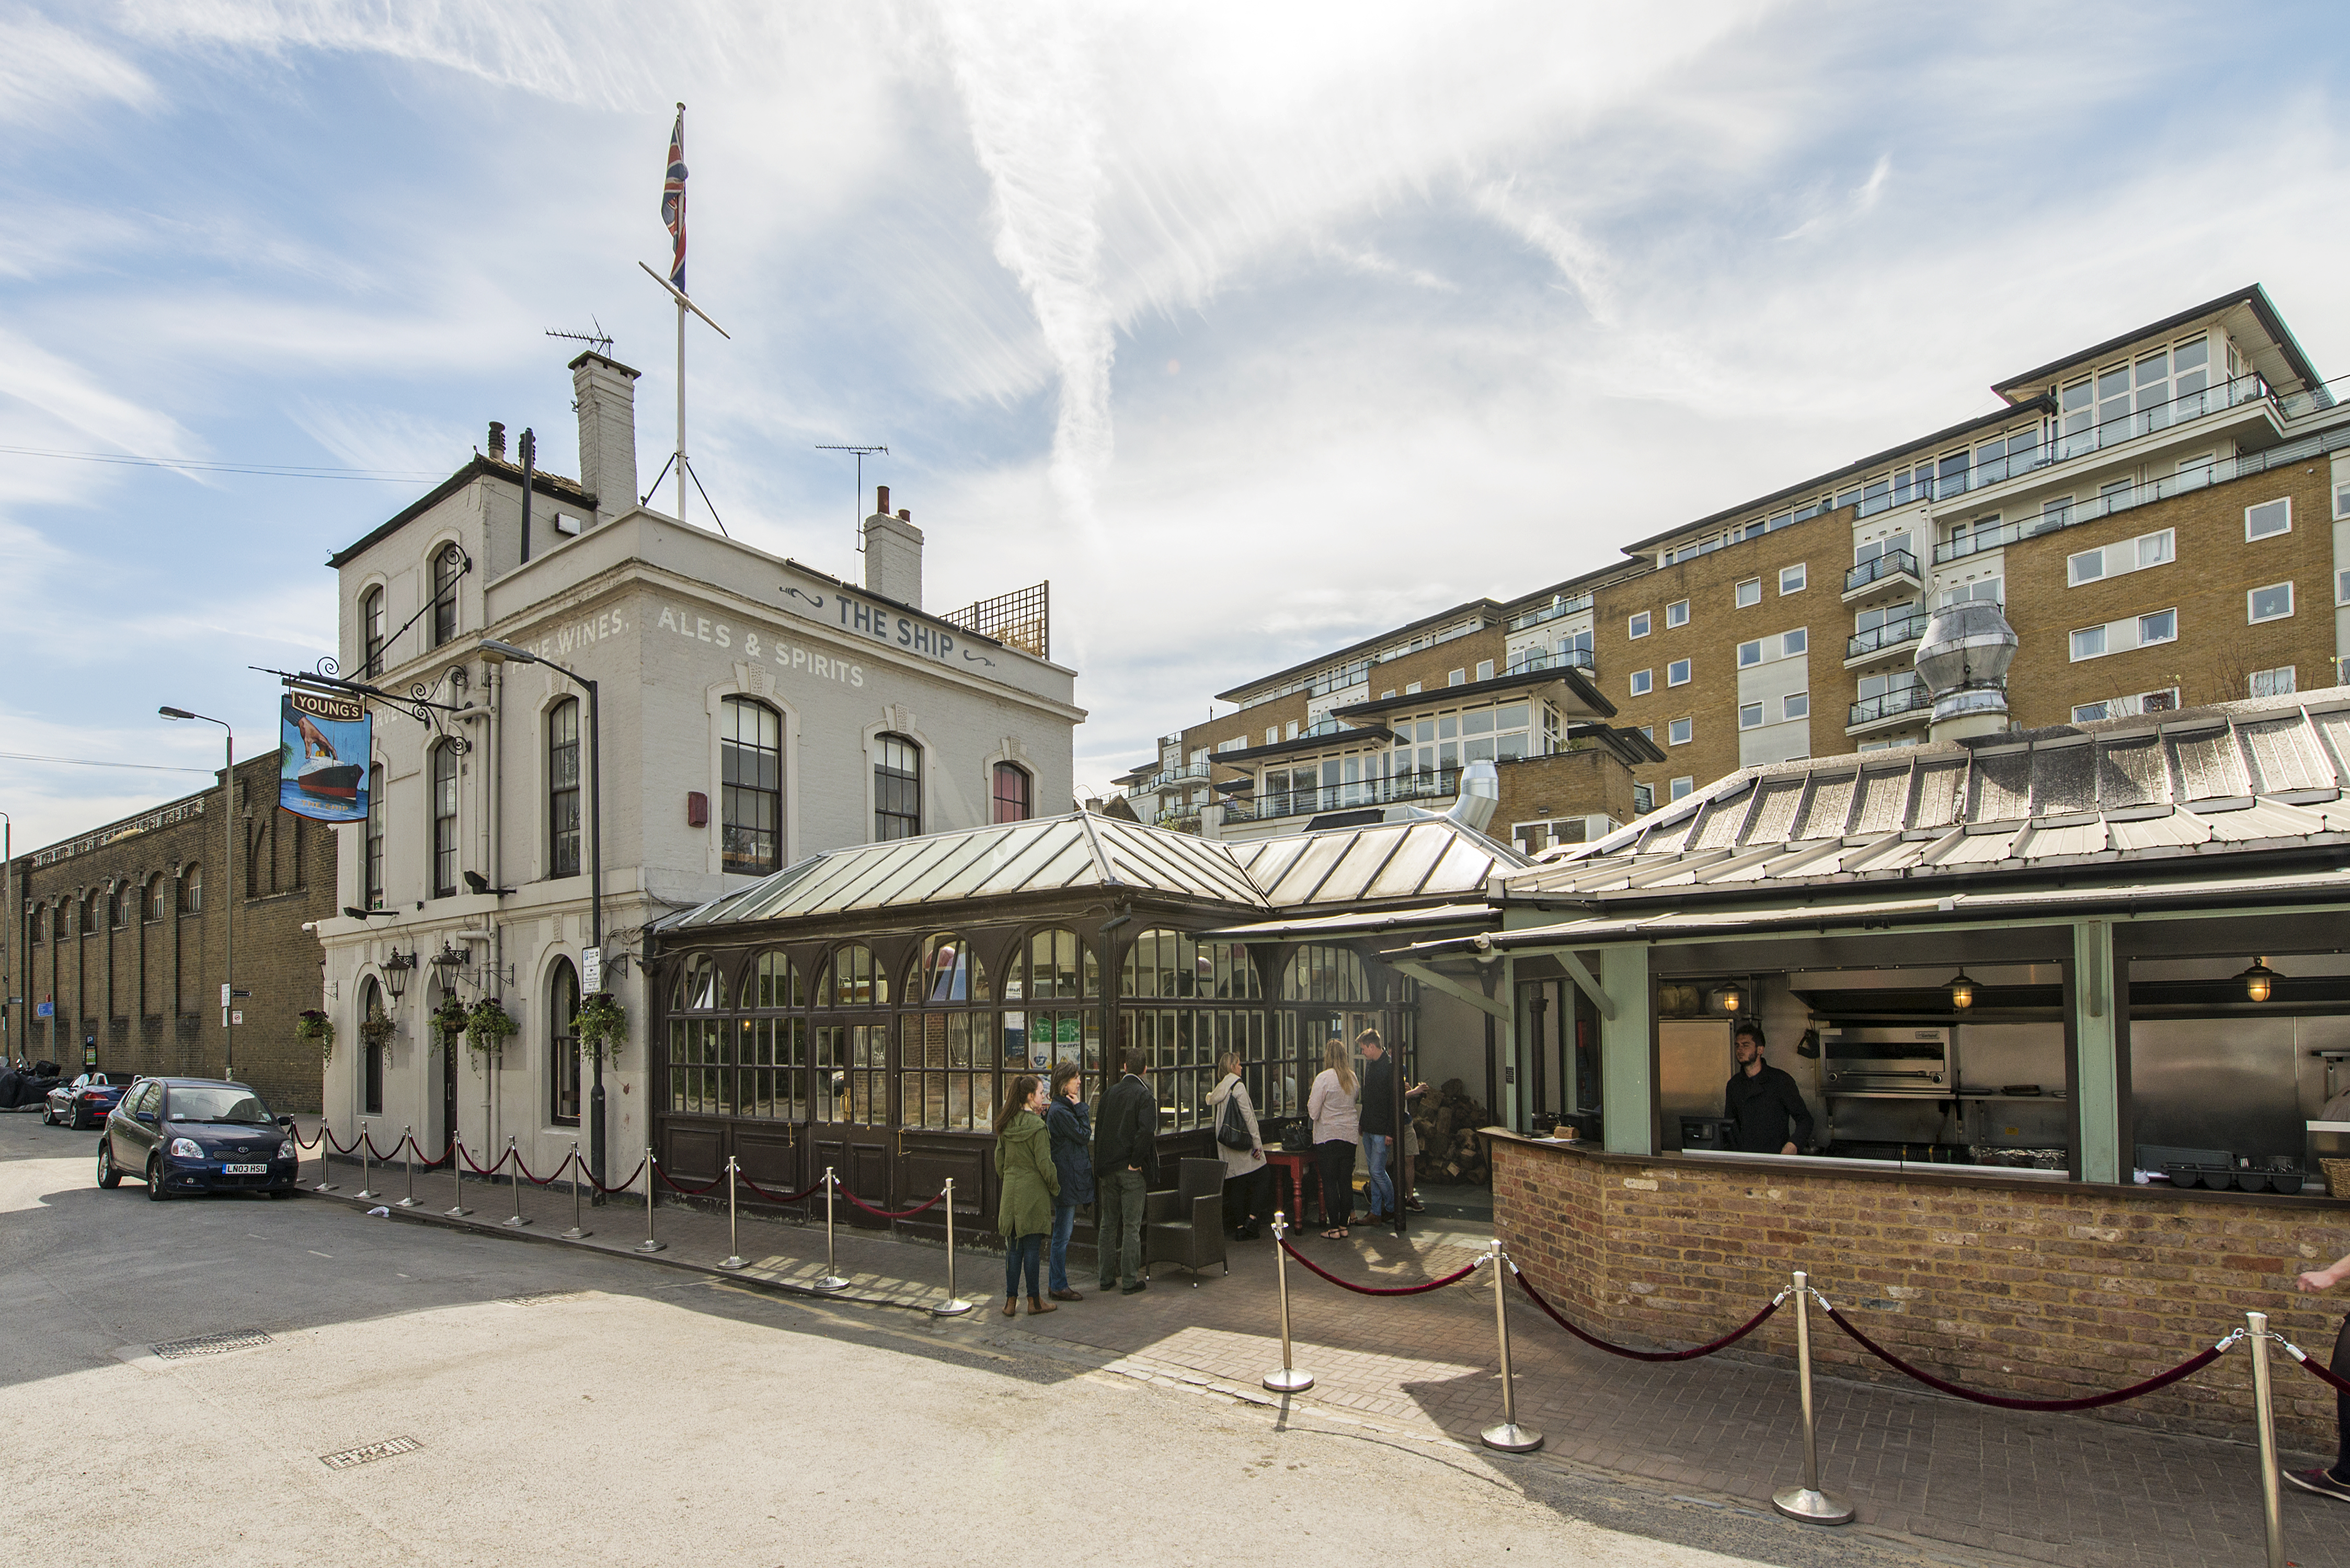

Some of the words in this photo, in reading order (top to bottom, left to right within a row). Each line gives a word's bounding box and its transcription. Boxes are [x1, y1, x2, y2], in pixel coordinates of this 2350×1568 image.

[557, 608, 629, 655] WINES,
[657, 606, 731, 648] ALES
[744, 633, 762, 659] &
[775, 642, 864, 688] SPIRITS
[835, 594, 887, 638] THE
[897, 618, 954, 659] SHIP
[298, 695, 359, 717] YOUNG'S
[301, 800, 321, 809] THE
[325, 803, 349, 812] SHIP
